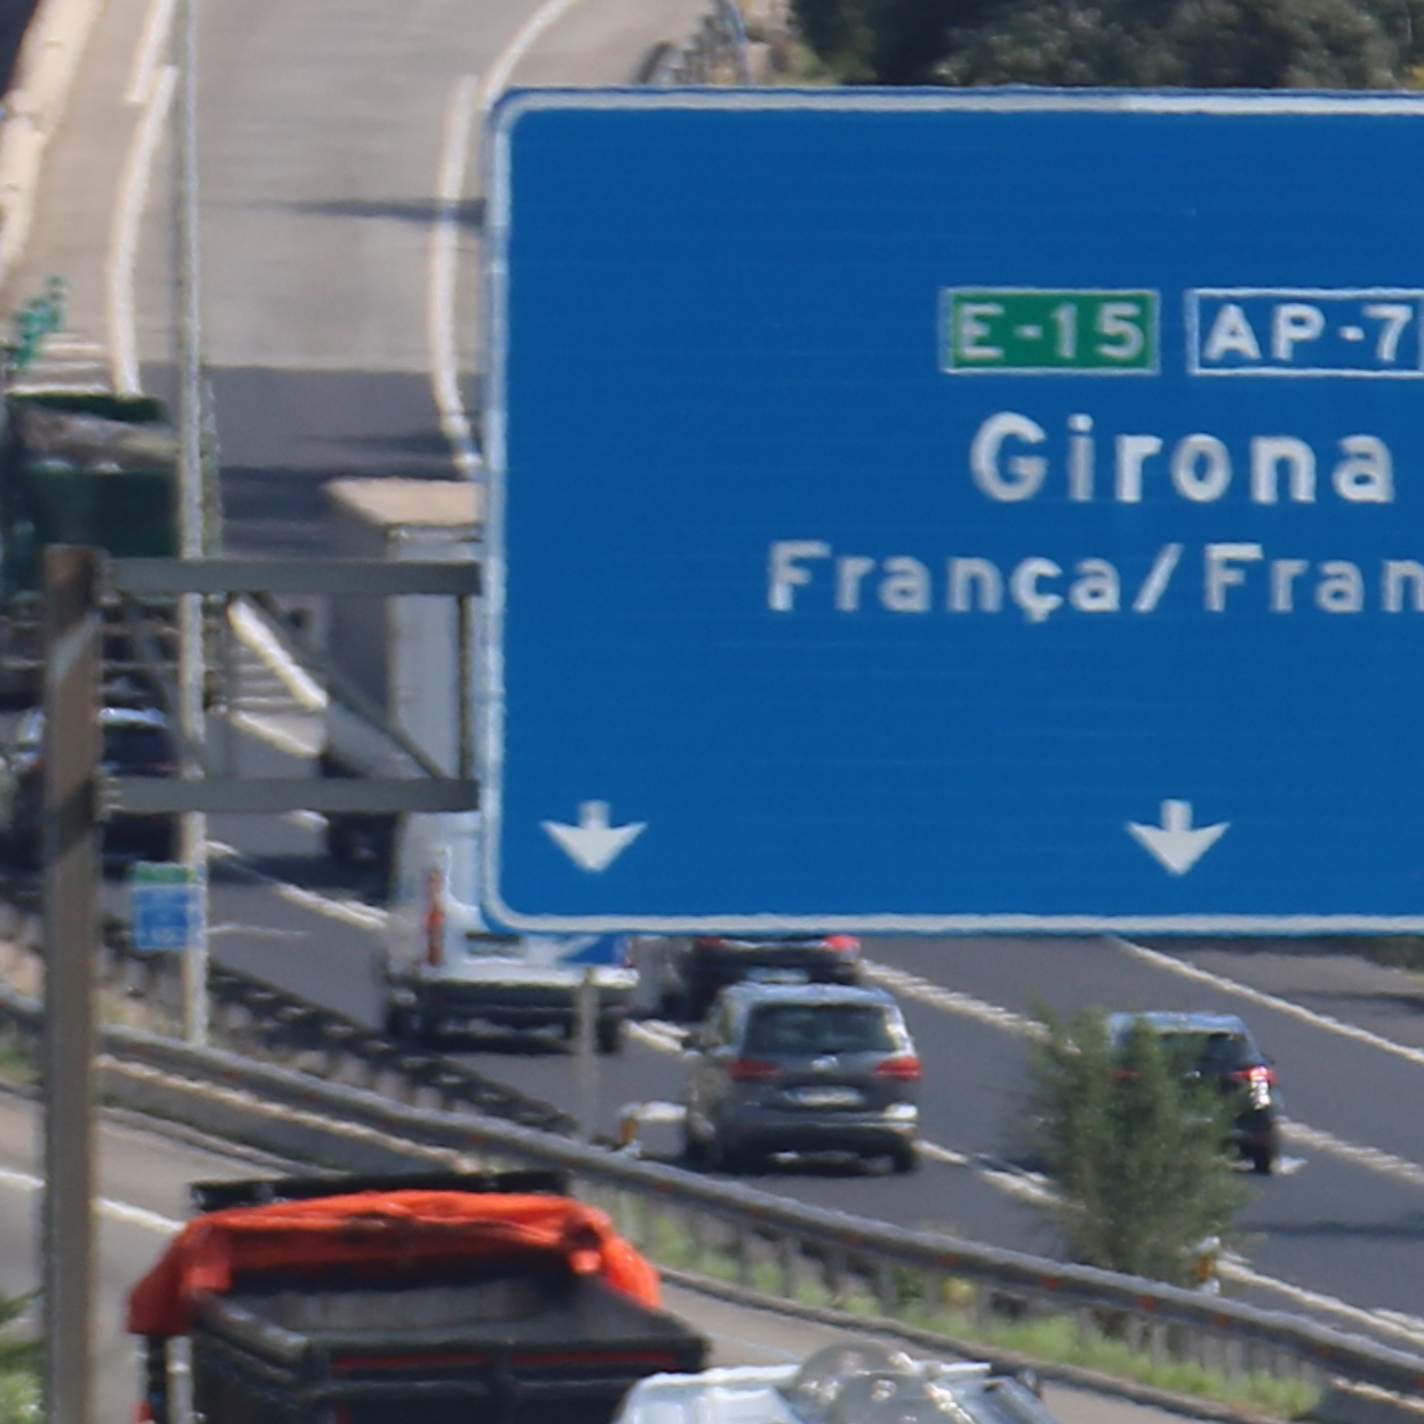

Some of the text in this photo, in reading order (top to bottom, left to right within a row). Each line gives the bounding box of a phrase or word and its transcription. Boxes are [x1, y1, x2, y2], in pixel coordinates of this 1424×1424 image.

[952, 303, 1143, 360] E-15
[1204, 303, 1415, 363] AP-7
[971, 412, 1394, 504] Girona
